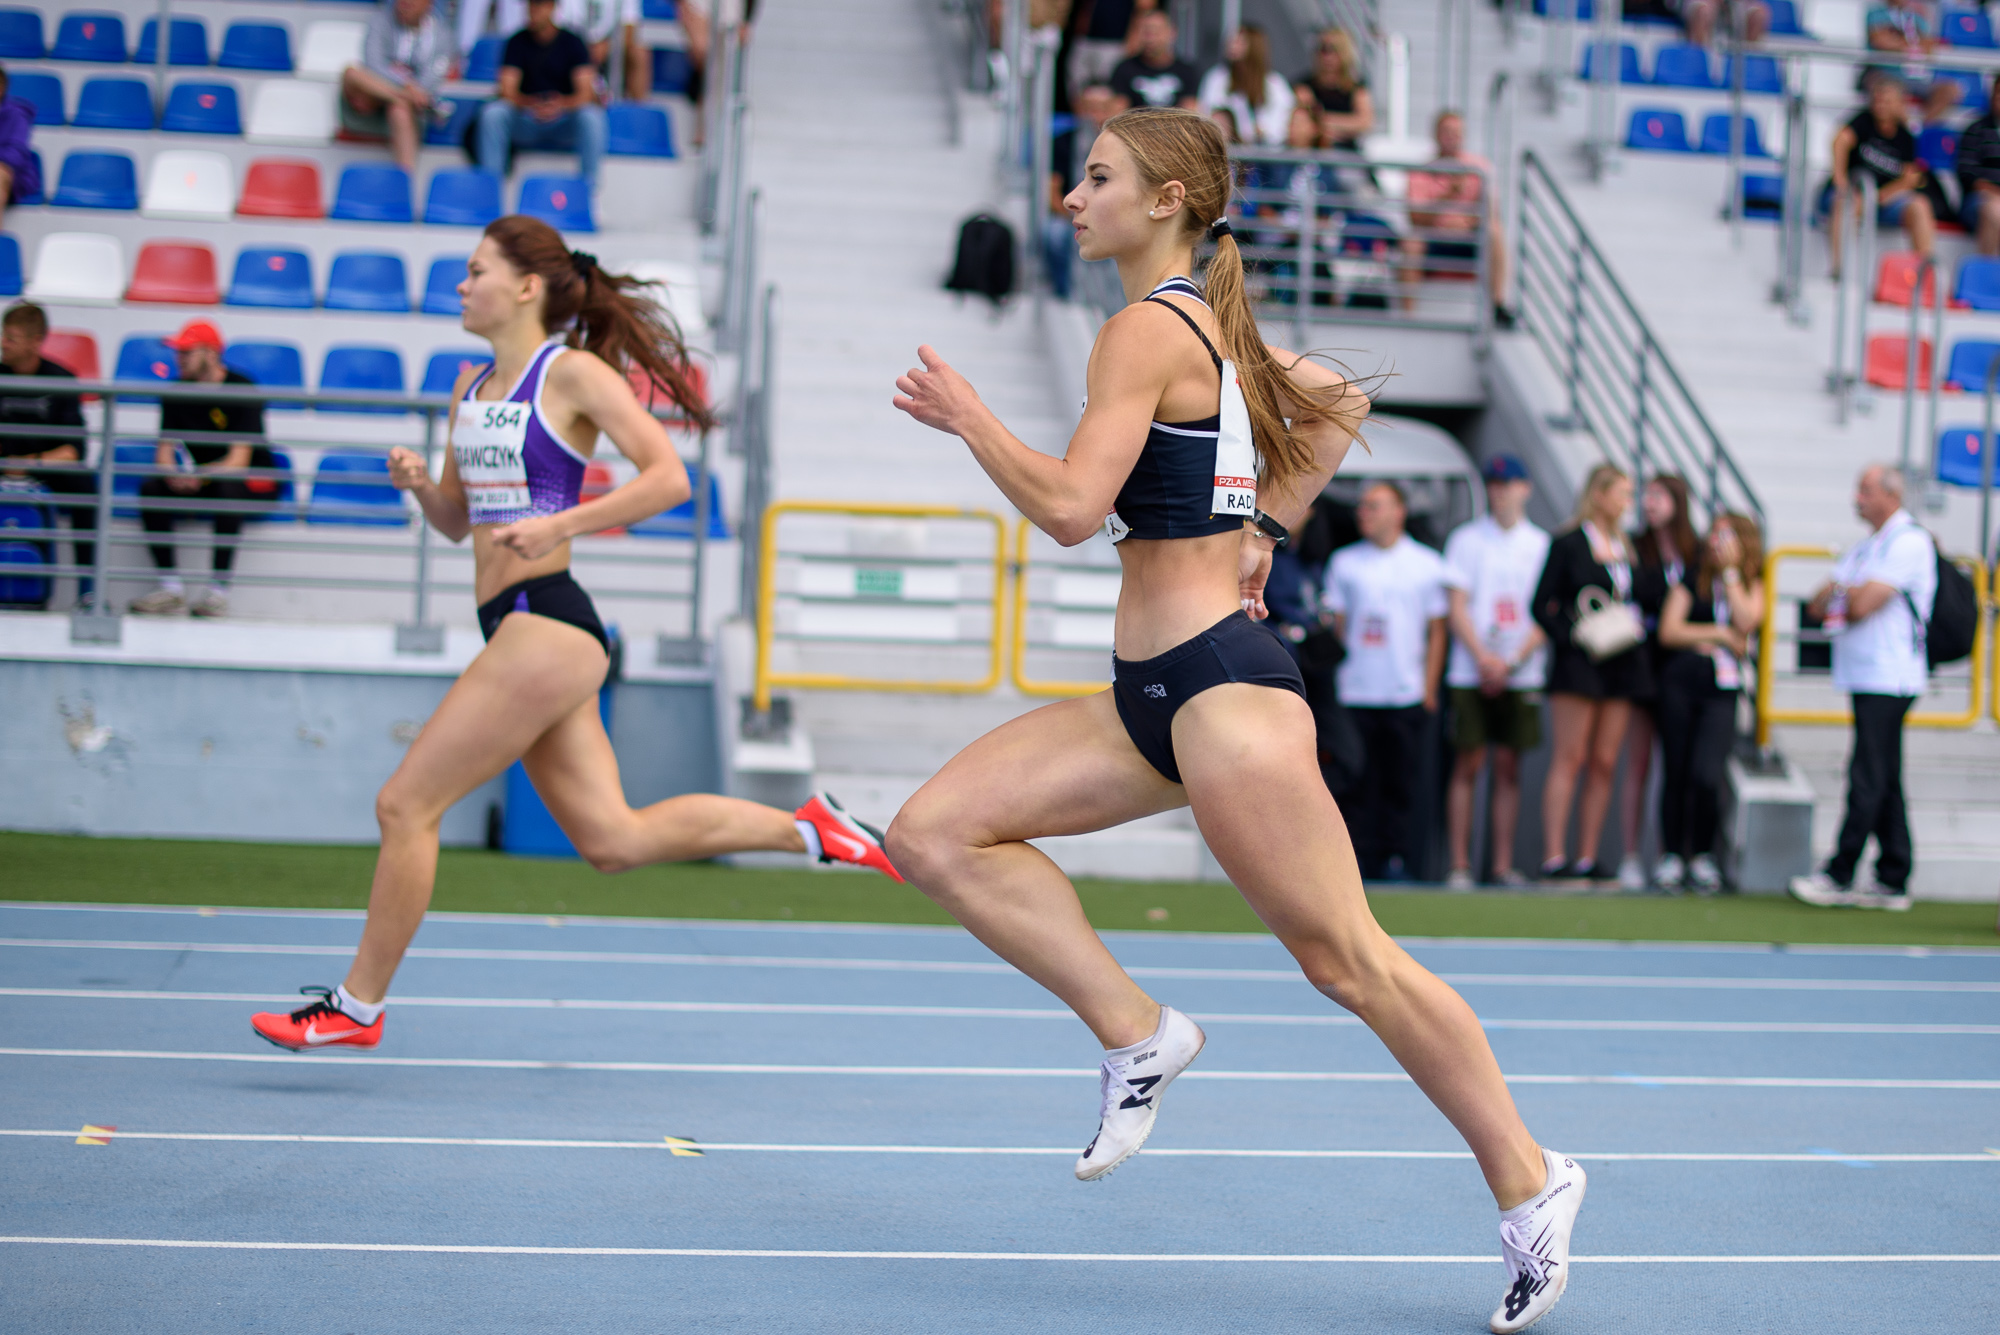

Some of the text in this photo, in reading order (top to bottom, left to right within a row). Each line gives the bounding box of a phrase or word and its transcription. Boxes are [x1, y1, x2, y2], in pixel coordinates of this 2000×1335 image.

[482, 406, 522, 429] 564
[1219, 477, 1242, 486] PZLA
[1535, 1180, 1572, 1210] new balance
